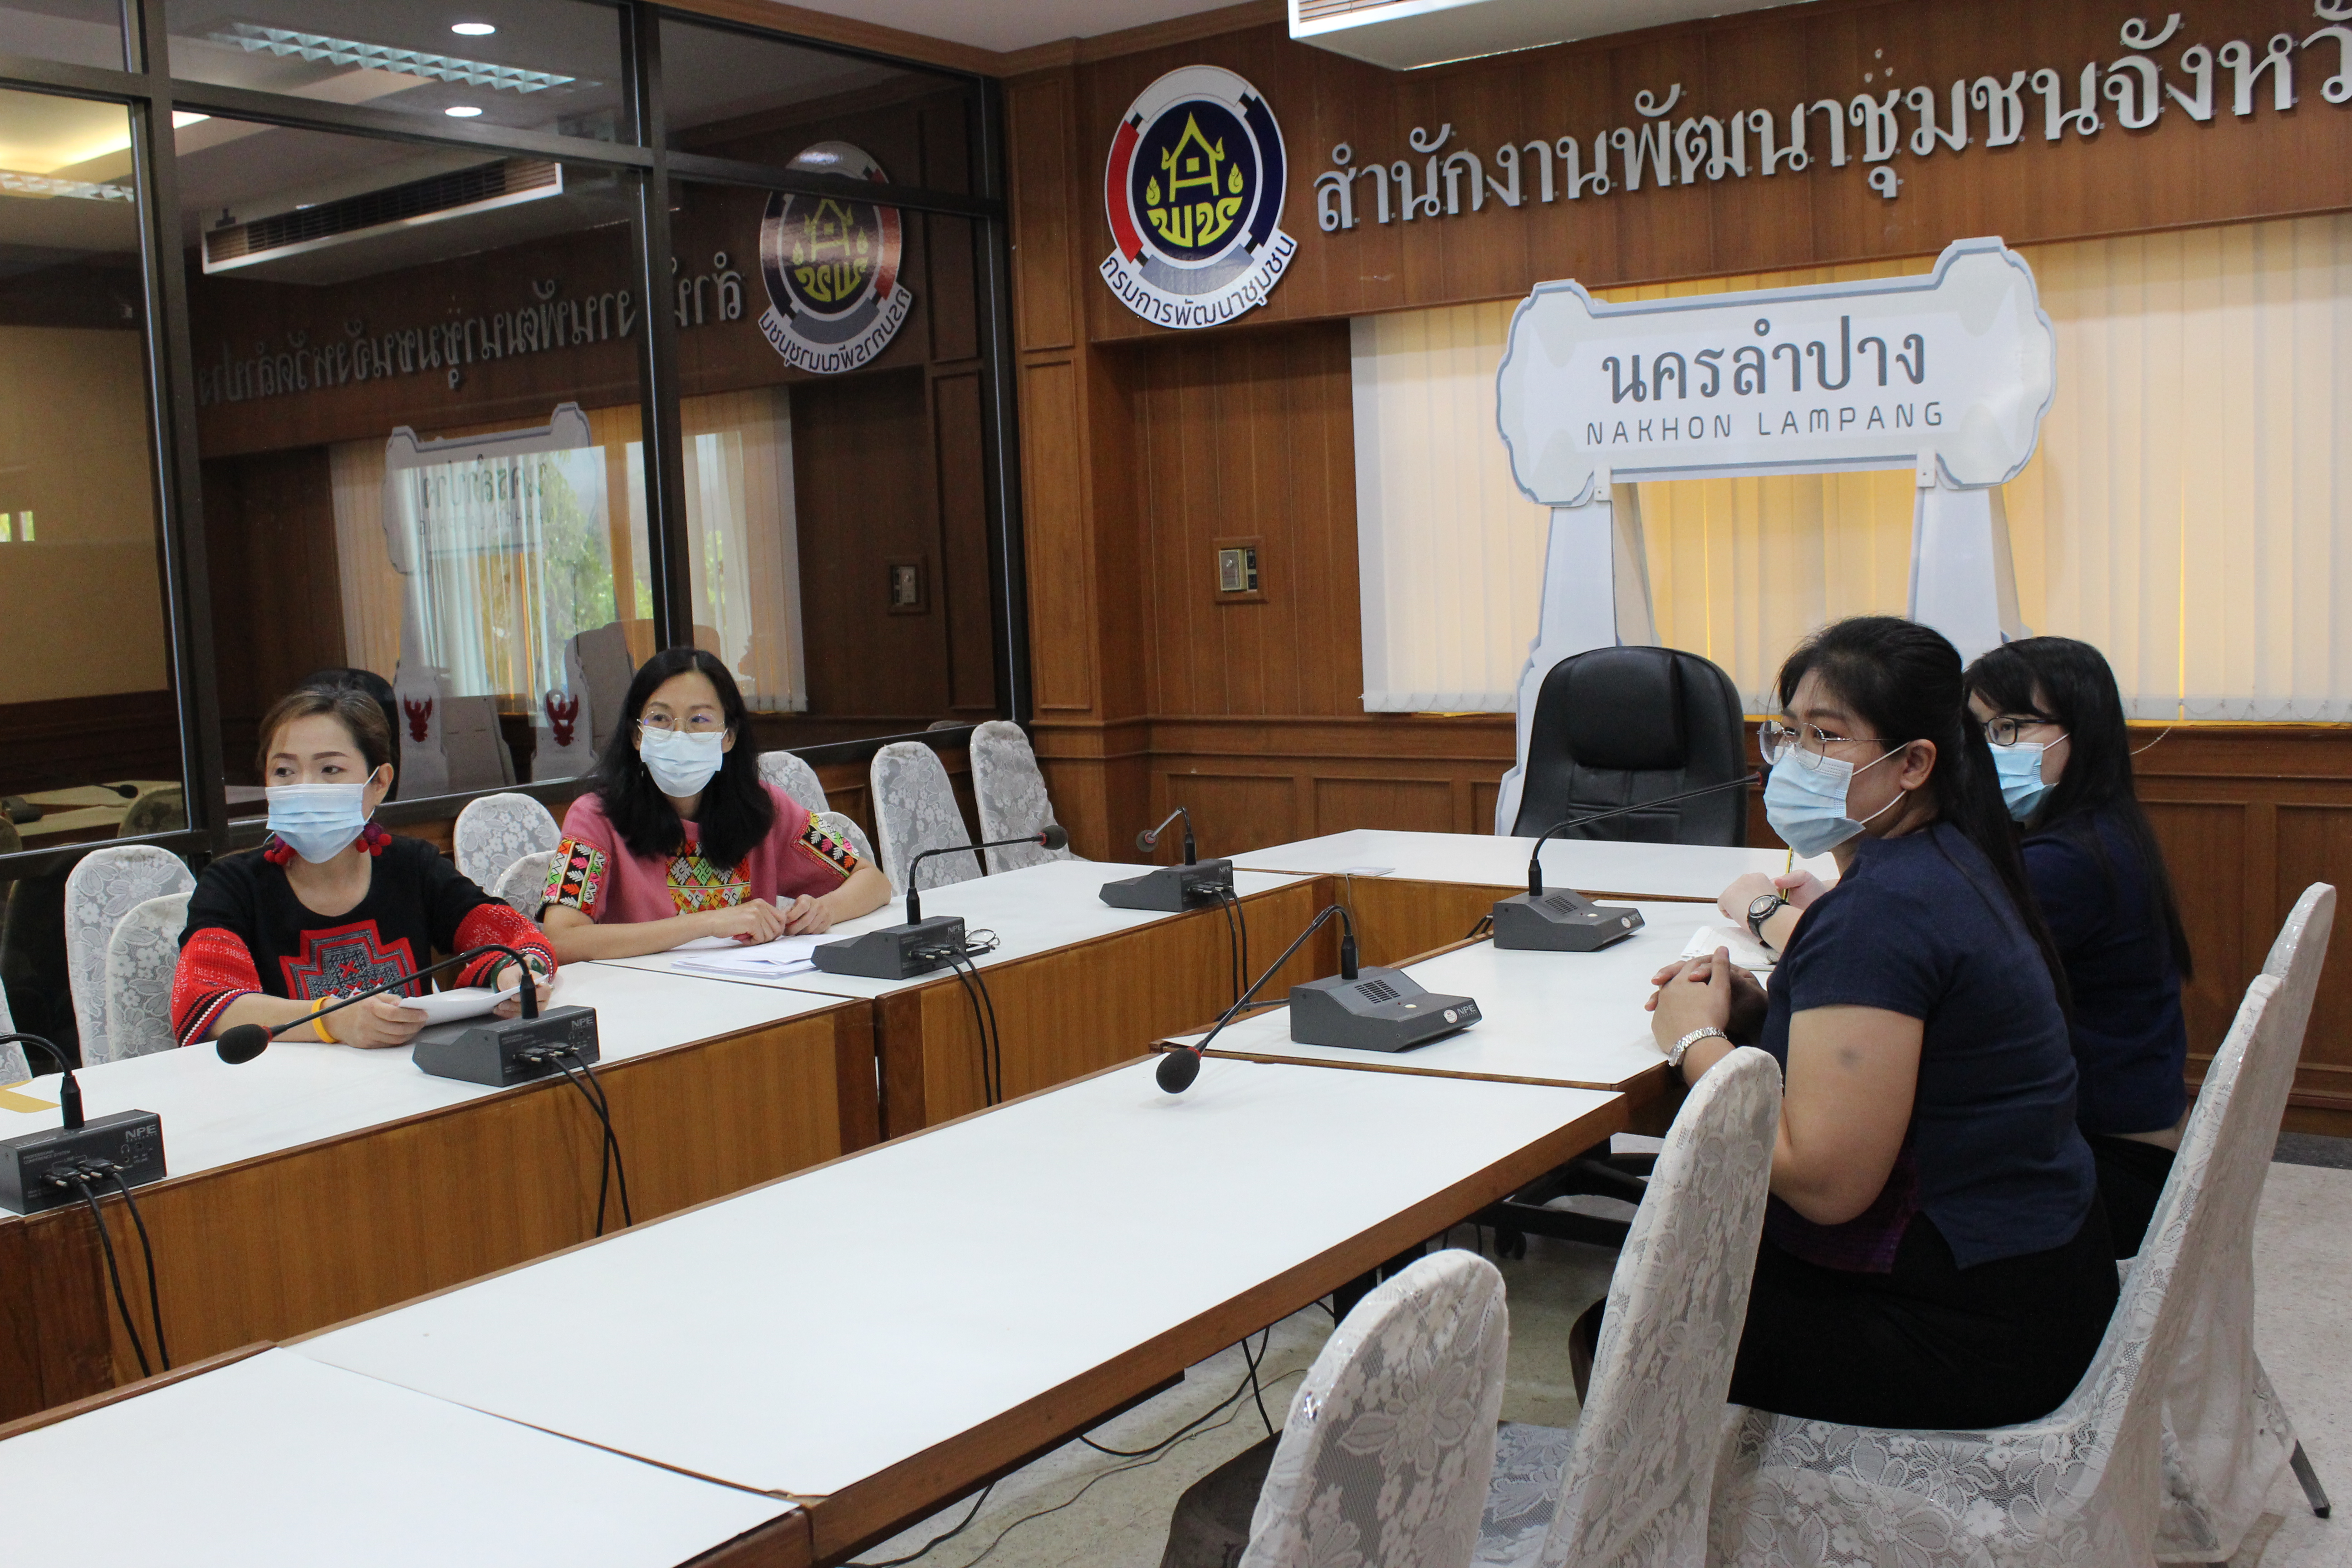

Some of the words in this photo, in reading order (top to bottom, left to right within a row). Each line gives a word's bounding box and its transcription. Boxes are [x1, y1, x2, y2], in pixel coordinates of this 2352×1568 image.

[1102, 235, 1294, 326] กรมการพัฒนาชุมชน
[1601, 315, 1926, 403] นครลำปาง
[1587, 413, 1731, 445] NAKHON
[1759, 402, 1941, 436] LAMPANG
[1628, 913, 1641, 921] NPE
[947, 924, 963, 933] NPE
[1457, 1004, 1476, 1015] NPE
[572, 1016, 593, 1028] NPE
[125, 1124, 157, 1140] NPE
